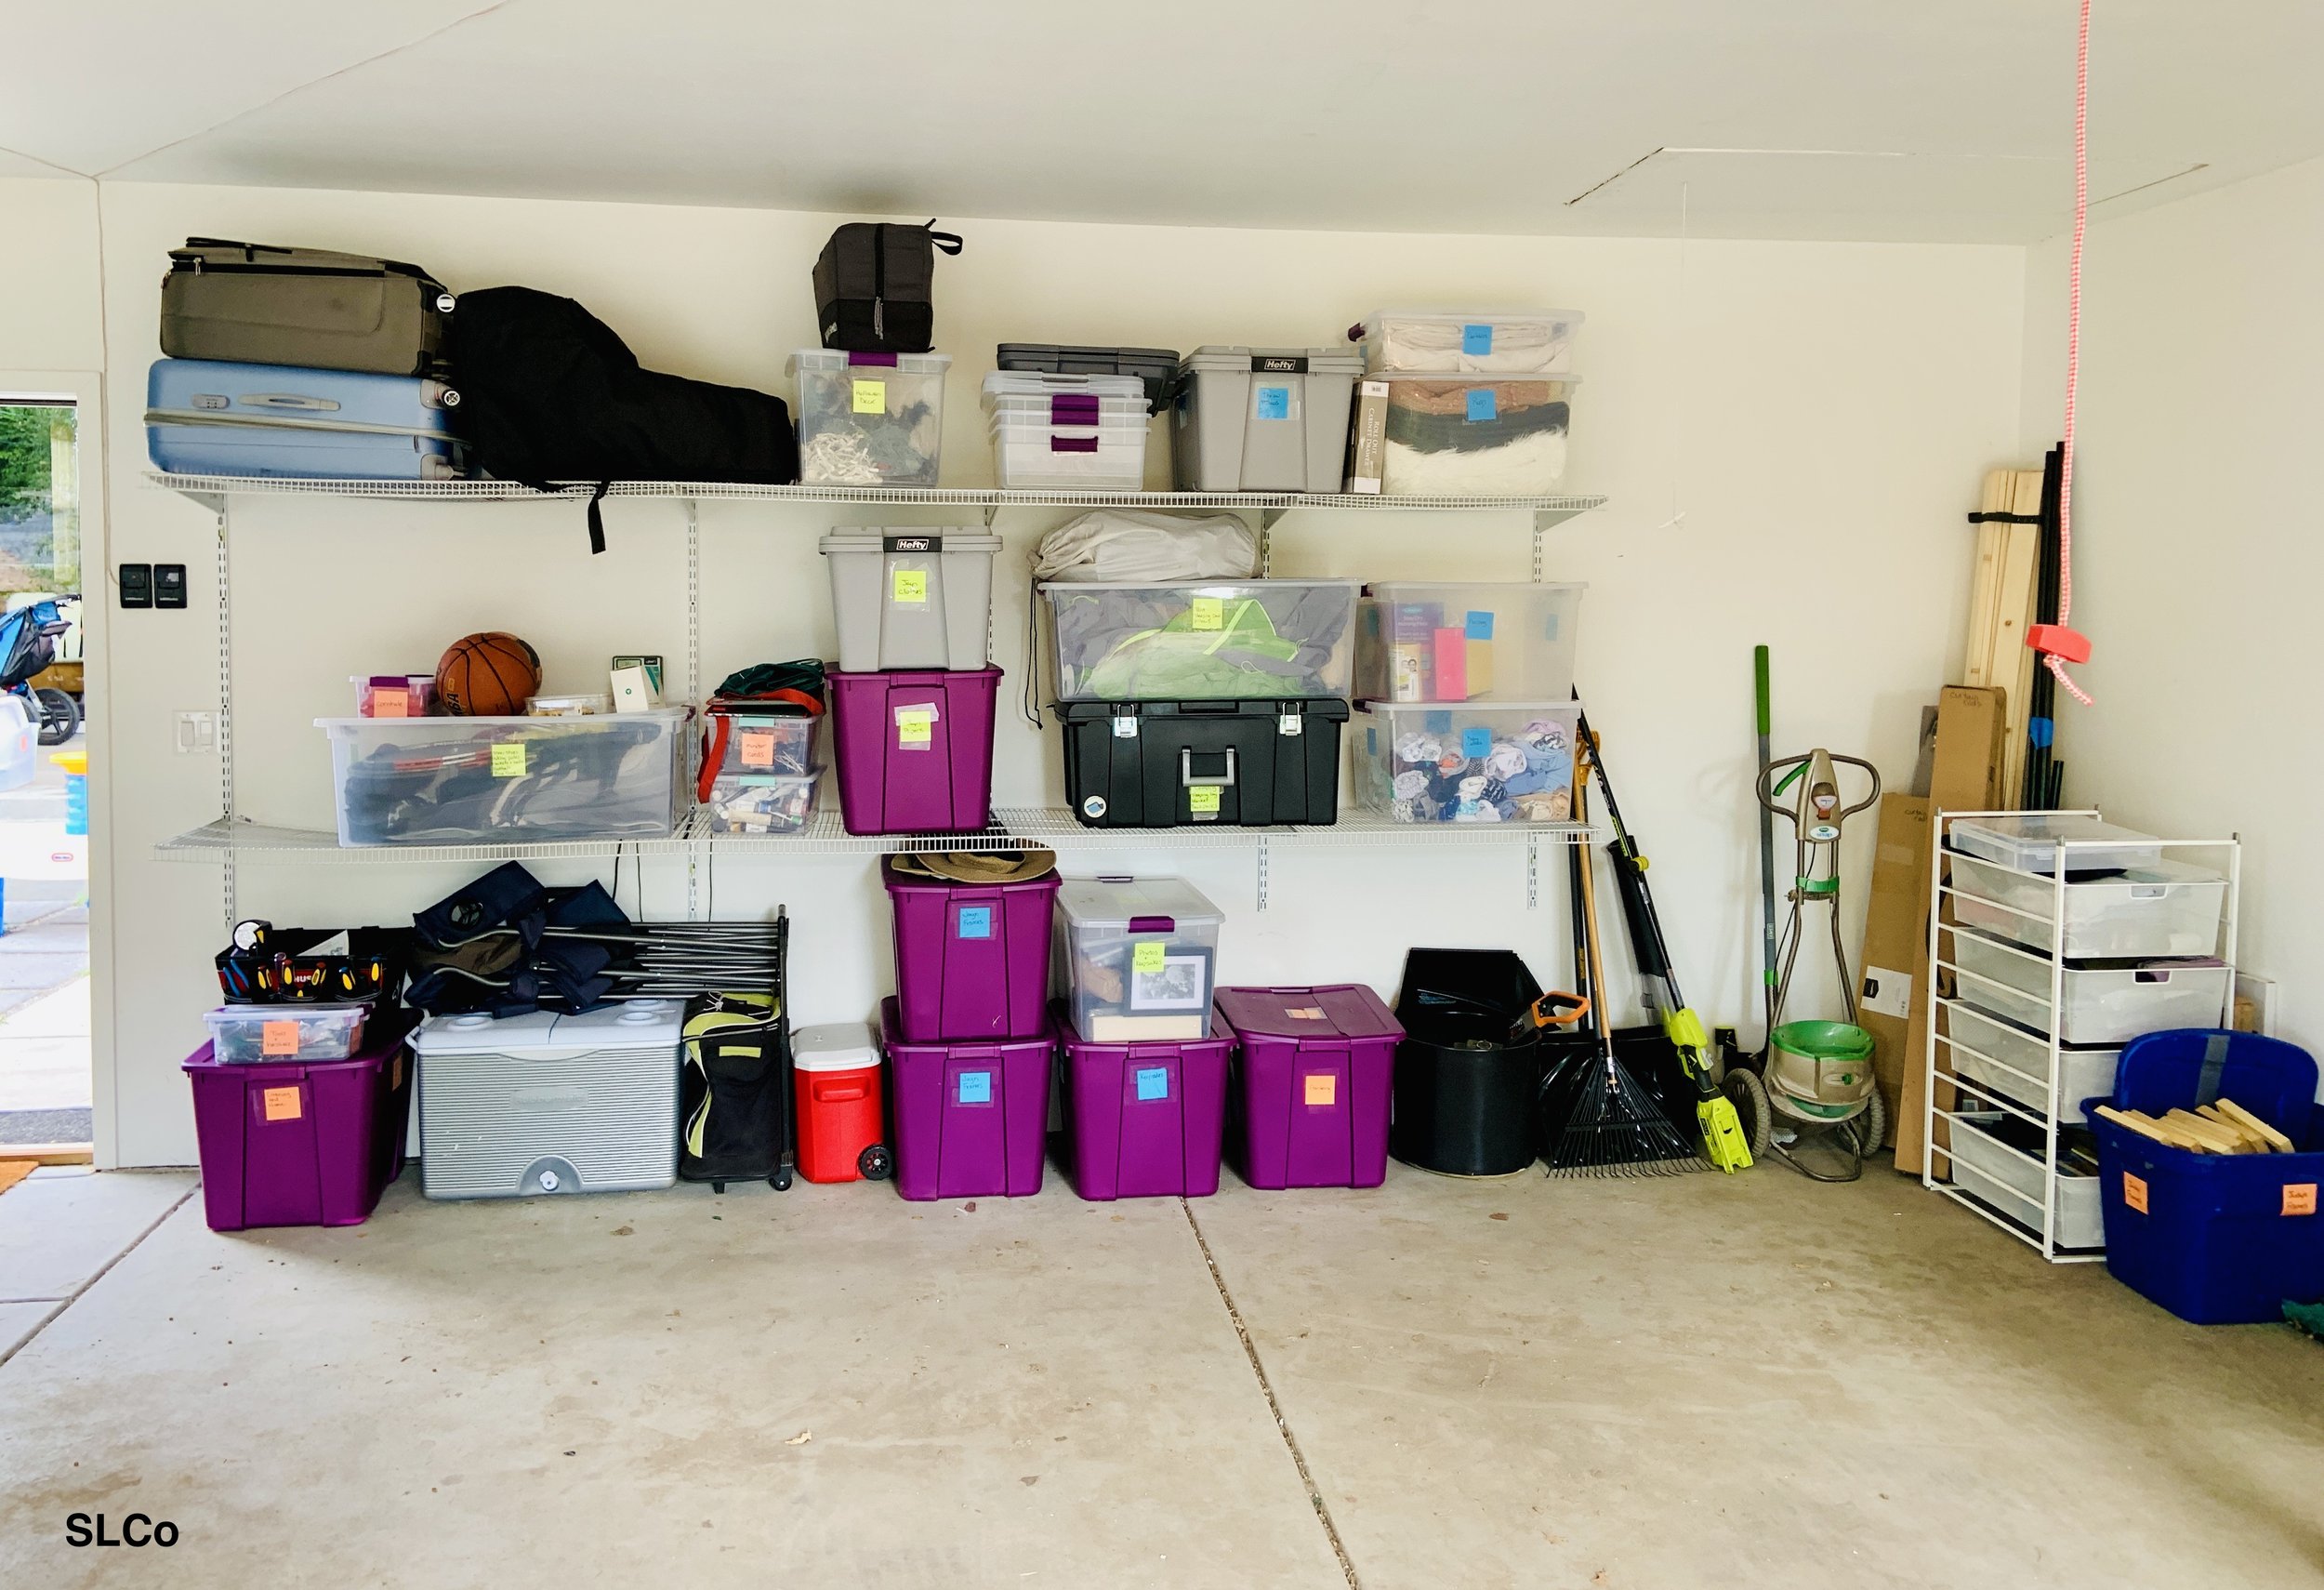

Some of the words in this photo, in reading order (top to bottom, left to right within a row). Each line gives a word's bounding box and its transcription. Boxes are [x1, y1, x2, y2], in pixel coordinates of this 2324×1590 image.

[1266, 359, 1294, 370] Hefty
[1372, 420, 1380, 437] ROLL
[1371, 438, 1380, 455] OUT
[899, 540, 927, 550] Hefty
